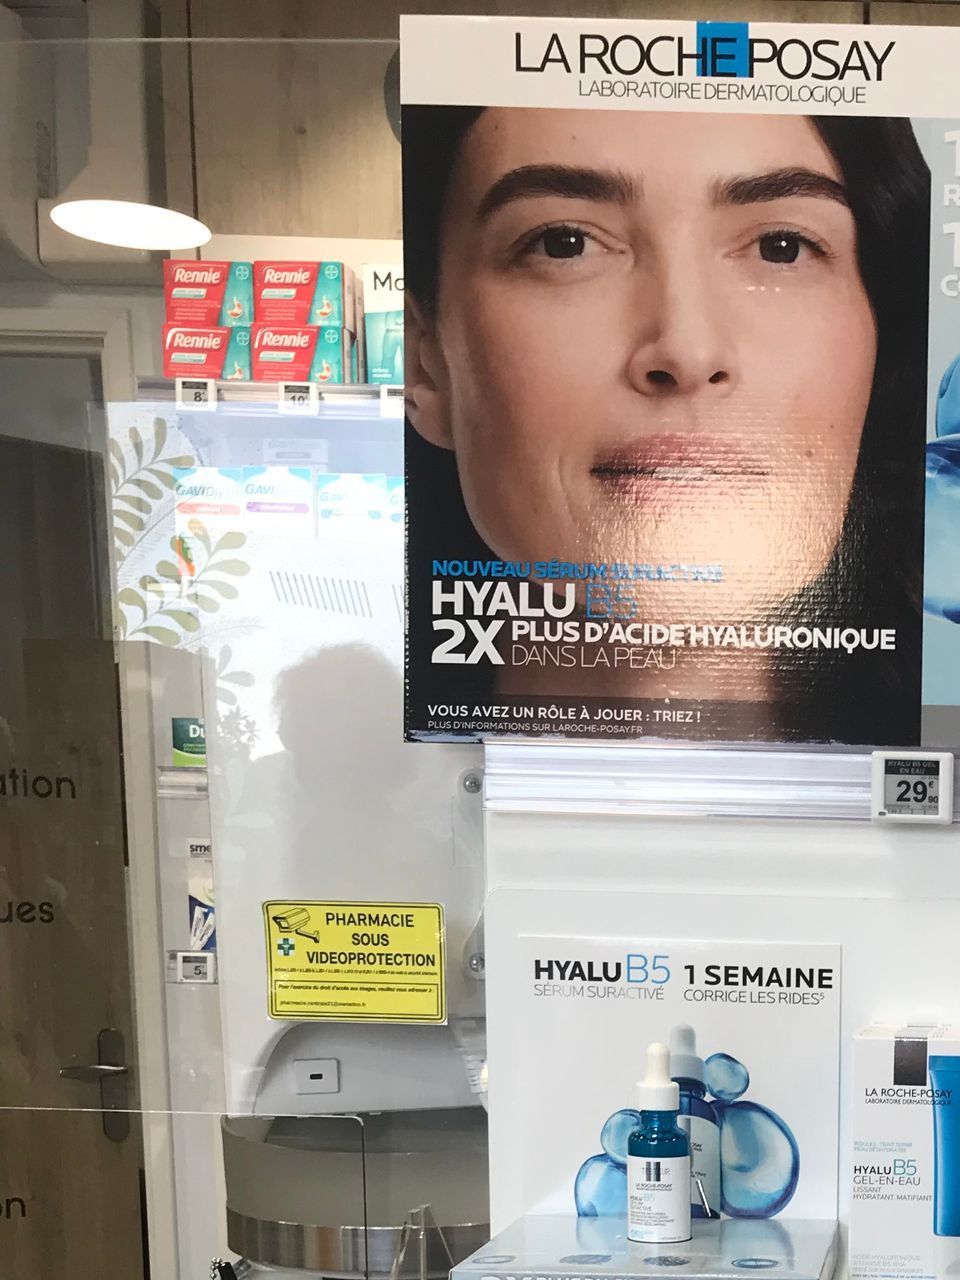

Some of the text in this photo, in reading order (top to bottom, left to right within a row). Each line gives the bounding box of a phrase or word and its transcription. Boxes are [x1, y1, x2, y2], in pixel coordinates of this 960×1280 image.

[514, 32, 896, 82] LA ROCHE POSAY
[578, 80, 866, 106] LABORATOIRE DERMATOLOGIQUE
[174, 269, 222, 284] Rennie
[264, 269, 311, 284] Rennie
[173, 332, 222, 349] Rennie
[263, 332, 311, 348] Rennie
[432, 560, 530, 578] NOUVEAU
[534, 559, 607, 580] SÉRUM
[432, 581, 638, 620] HYALU B5
[431, 619, 505, 666] 2X
[511, 620, 580, 643] PLUS
[690, 626, 897, 654] HYALURONIQUE
[511, 645, 576, 668] DANS
[580, 647, 611, 668] LA
[427, 704, 469, 719] VOUS
[472, 705, 511, 719] AVEZ
[513, 706, 536, 720] UN
[540, 704, 577, 720] RÔLE
[580, 705, 591, 720] À
[593, 707, 643, 722] JOUER
[428, 720, 643, 735] PLUS D'INFORMATIONS SUR LAROCHE-POSAY.FR
[325, 912, 414, 928] PHARMACIE
[351, 933, 390, 946] SOUS
[306, 951, 436, 967] VIDEOPROTECTION
[534, 953, 834, 990] HYALU B5 1 SEMAINE
[533, 984, 585, 998] SÉRUM
[587, 984, 664, 1000] SURACTIVÉ
[683, 988, 747, 1003] CORRIGE
[749, 990, 776, 1004] LES
[865, 1087, 952, 1099] LA ROCHE-POSAY
[854, 1158, 917, 1176] HYALU B5
[853, 1175, 921, 1186] GEL-EN-EAU
